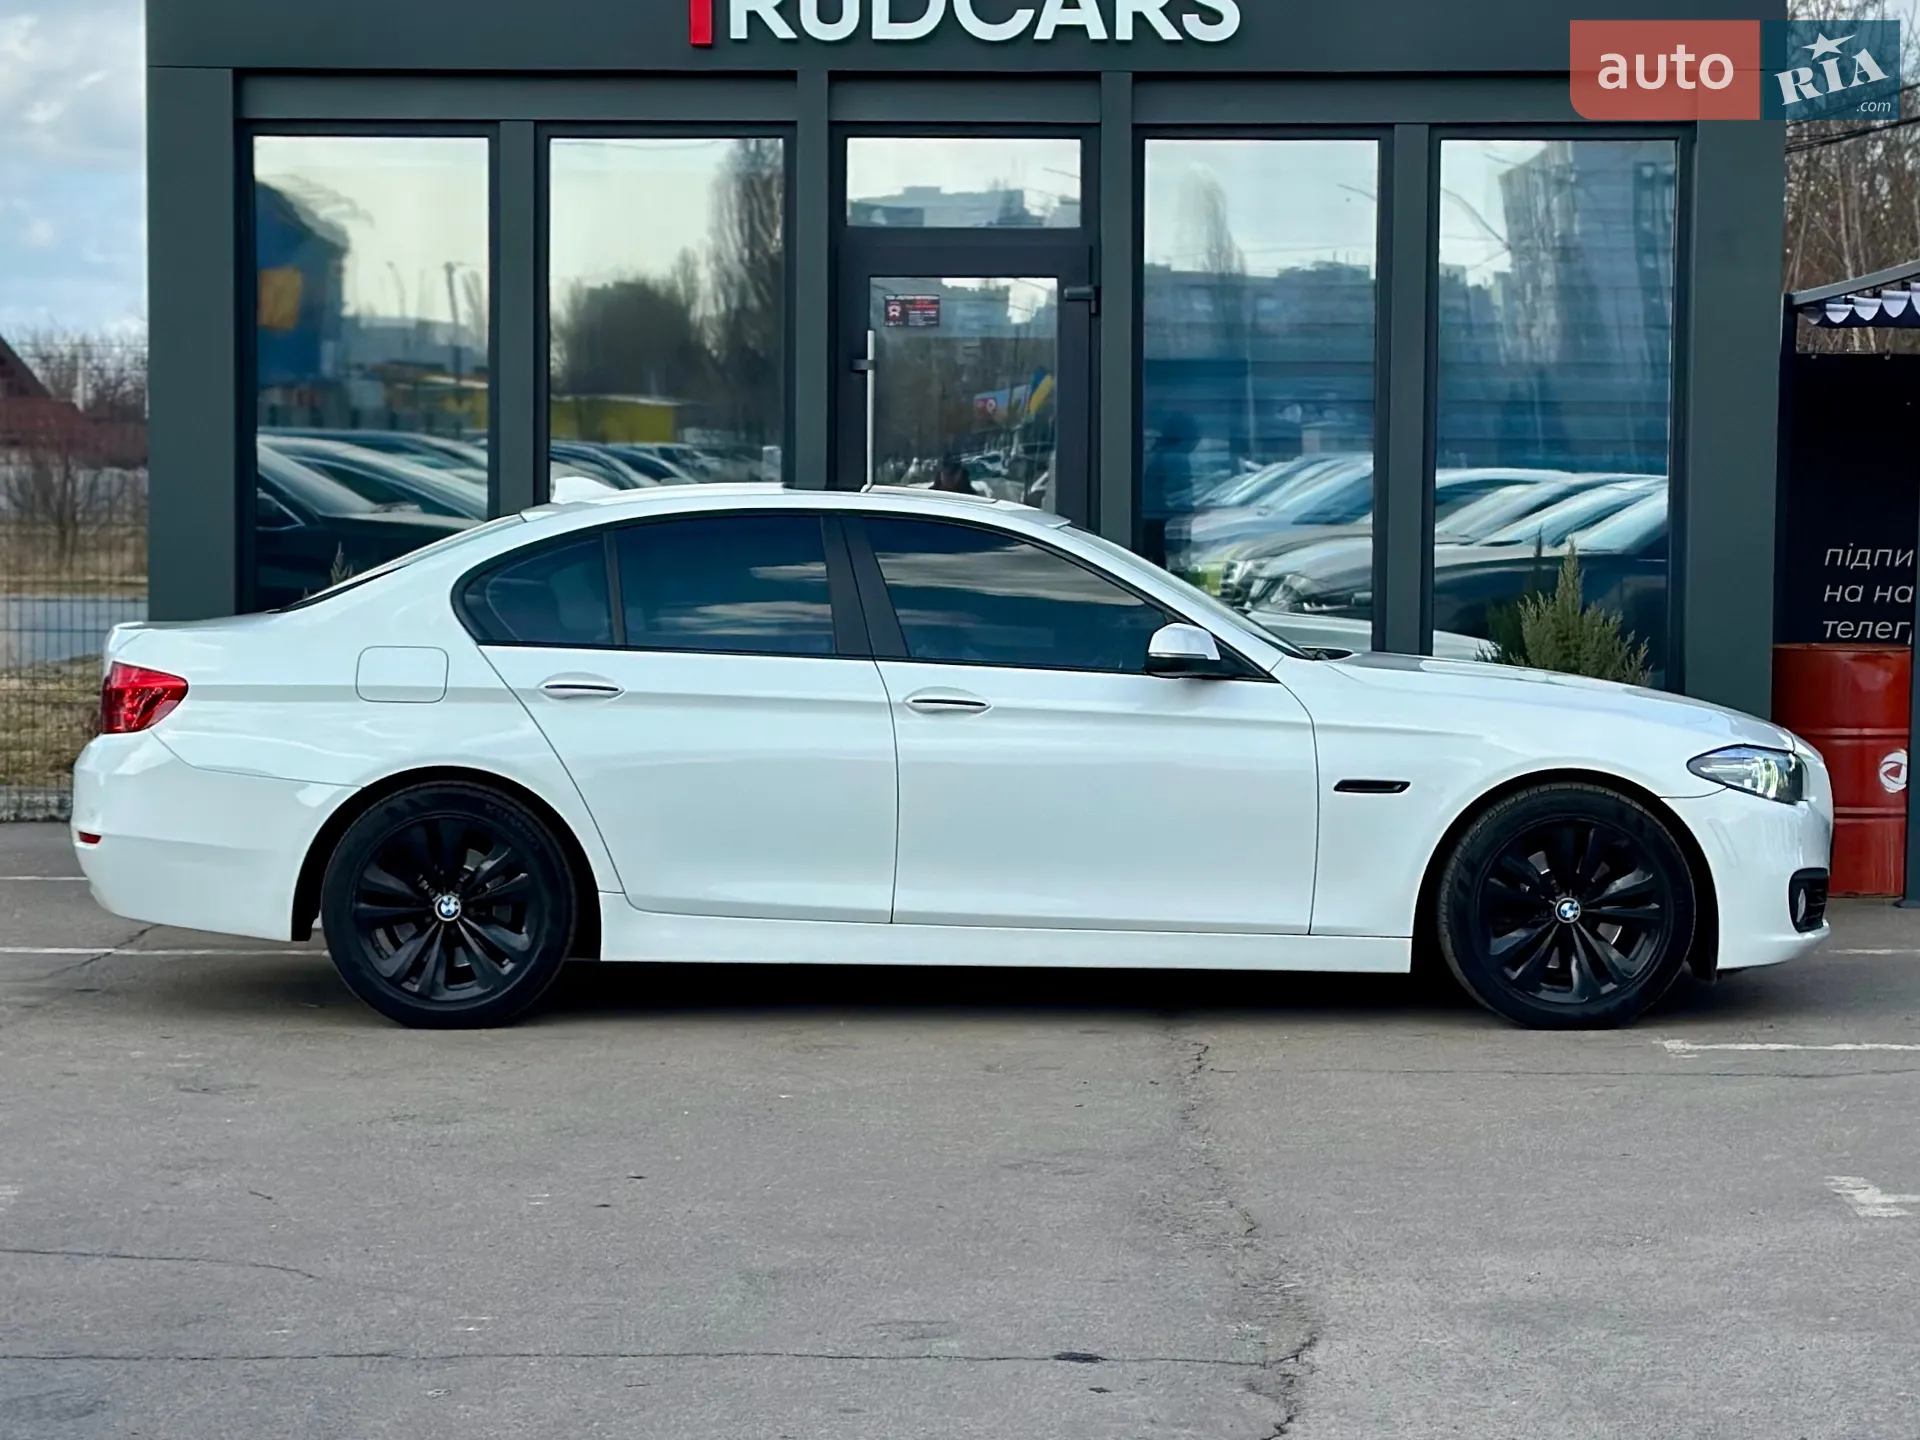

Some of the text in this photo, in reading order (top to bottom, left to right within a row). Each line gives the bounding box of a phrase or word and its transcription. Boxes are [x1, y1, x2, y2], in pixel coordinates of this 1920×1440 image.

[1824, 543, 1914, 571] підпи
[1824, 584, 1914, 604] на на
